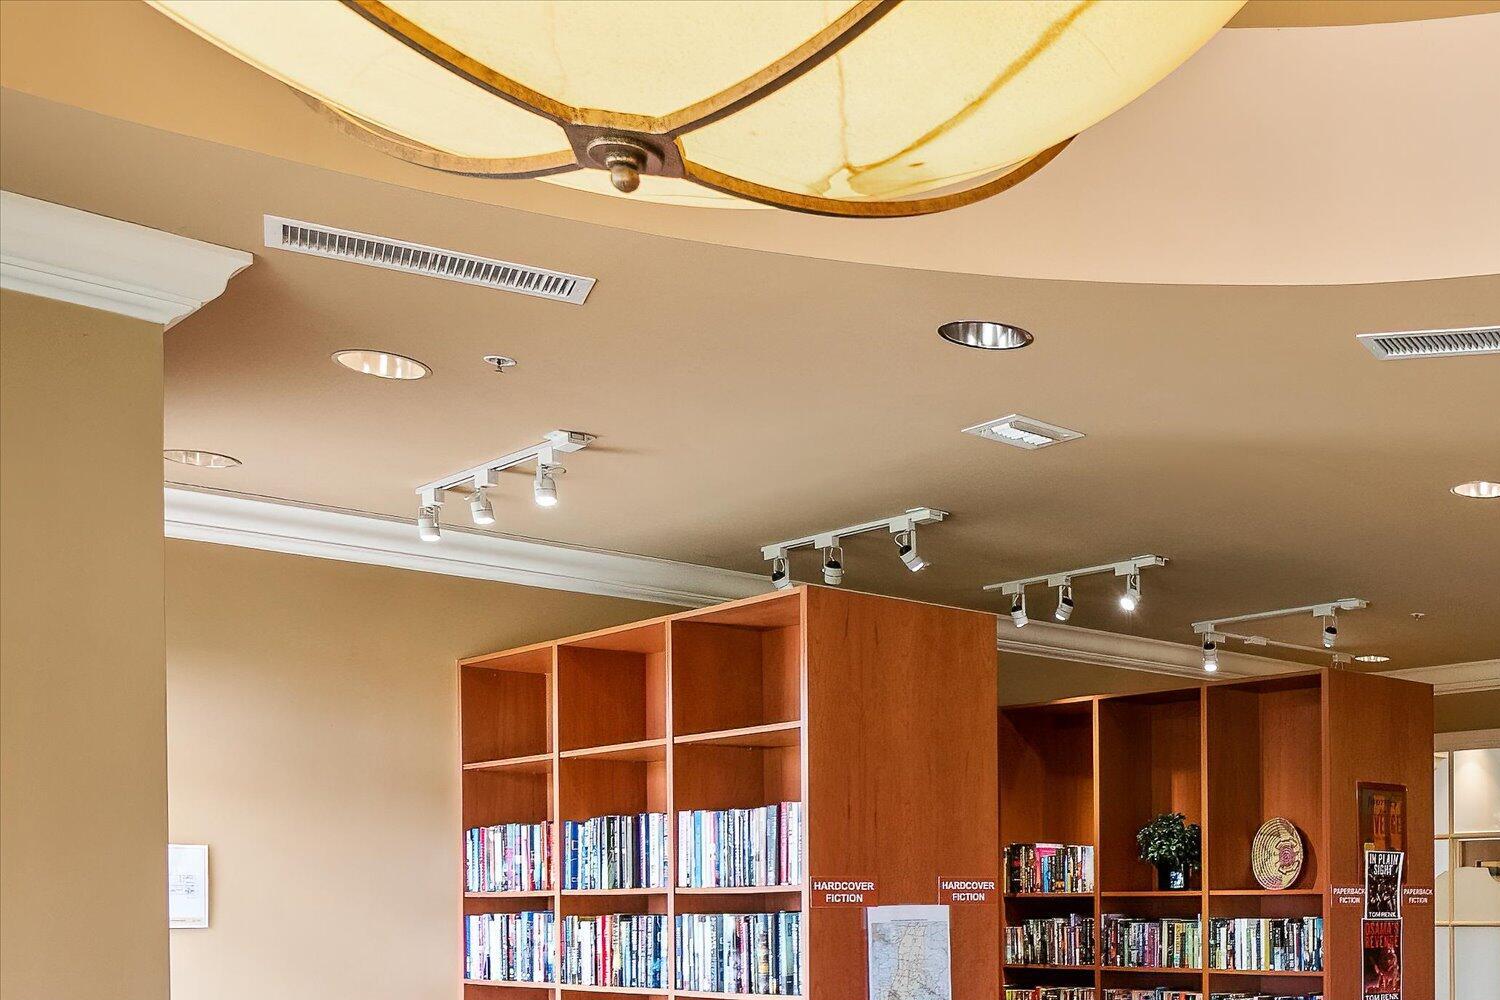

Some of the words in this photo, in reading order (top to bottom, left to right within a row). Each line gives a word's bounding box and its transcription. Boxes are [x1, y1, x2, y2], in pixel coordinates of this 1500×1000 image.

[1369, 853, 1377, 864] IN
[1378, 853, 1399, 864] PLAIN
[1373, 864, 1393, 875] SIGHT
[813, 881, 875, 891] HARDCOVER
[941, 881, 995, 890] HARDCOVER
[1333, 887, 1366, 895] PAPERBACK
[825, 893, 863, 902] FICTION
[952, 892, 985, 901] FICTION
[1339, 896, 1361, 904] FICTION
